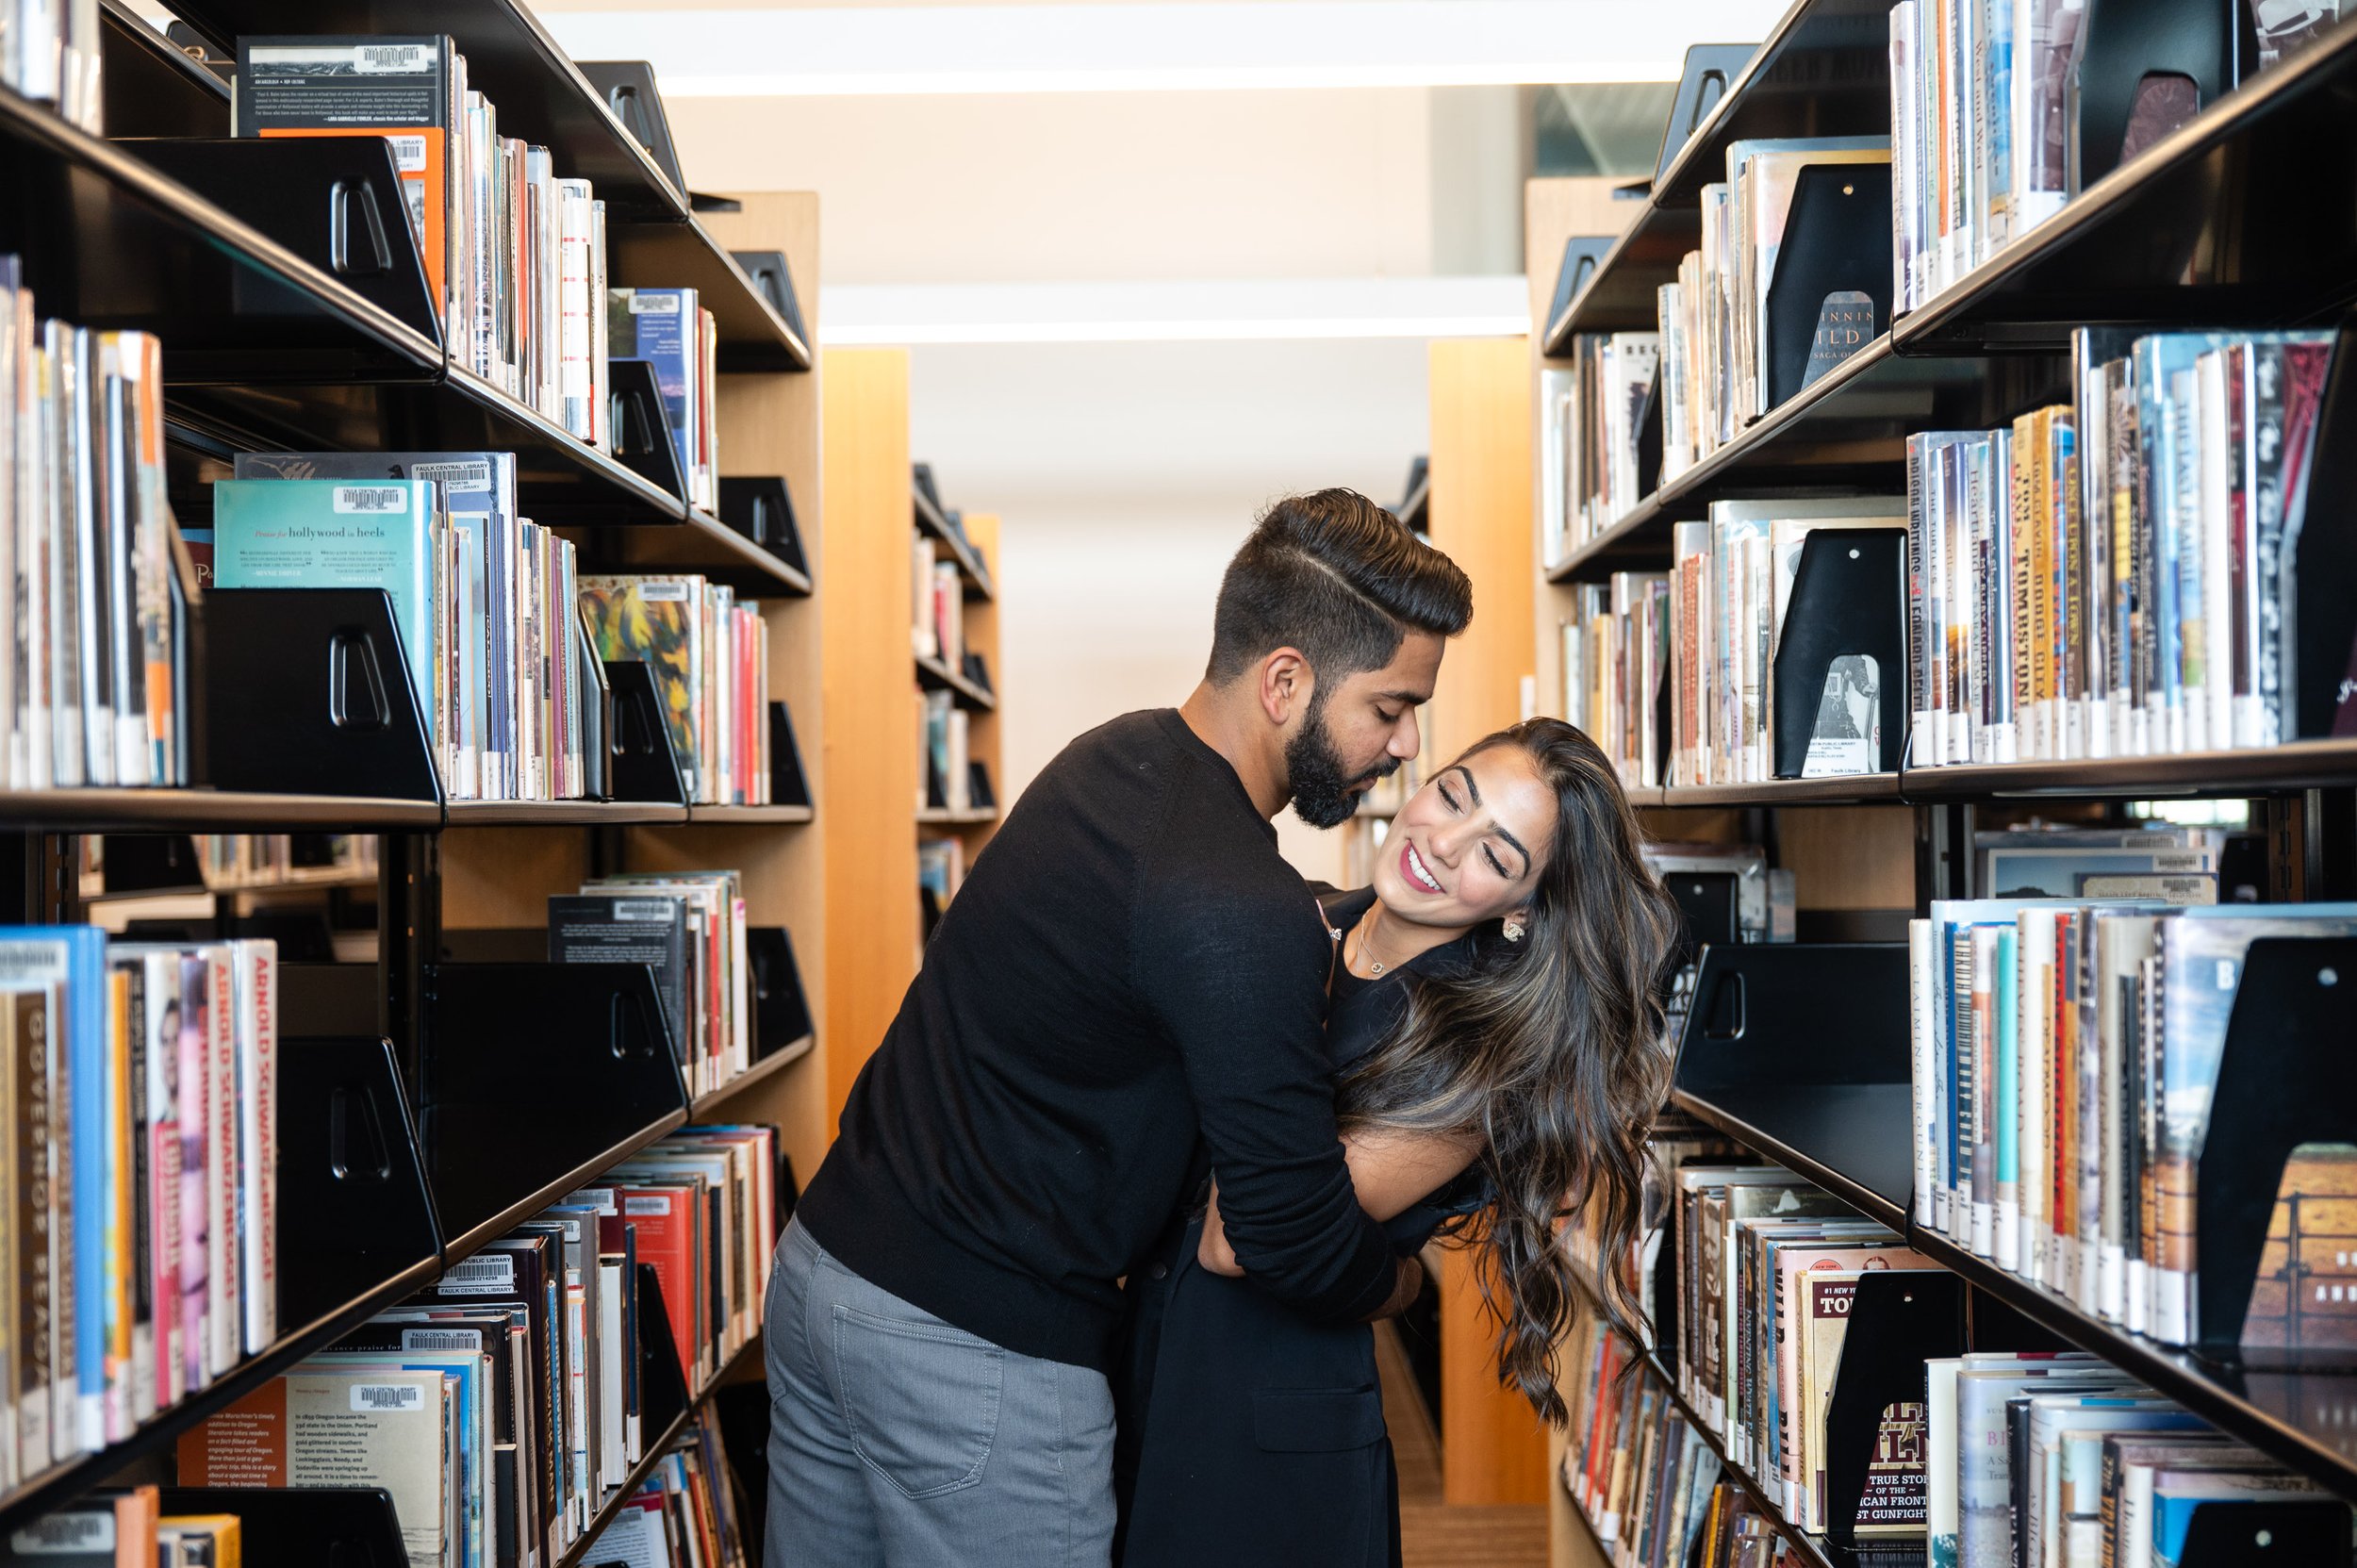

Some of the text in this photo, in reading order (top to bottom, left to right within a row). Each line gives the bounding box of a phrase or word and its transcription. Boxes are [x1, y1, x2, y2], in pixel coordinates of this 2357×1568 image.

[288, 527, 345, 541] hollywood
[357, 527, 385, 537] heels
[1945, 510, 1956, 603] heartland
[1970, 470, 1980, 572] Heartland
[2036, 574, 2044, 639] DODGE
[2036, 652, 2045, 699] CITY
[216, 964, 230, 1065] ARNOLD
[255, 957, 270, 1054] ARNOLD
[1913, 964, 1922, 1074] CLAIMING
[1821, 1297, 1853, 1313] TO
[545, 1317, 553, 1442] KENNEWICK
[1869, 1475, 1899, 1485] TRUE
